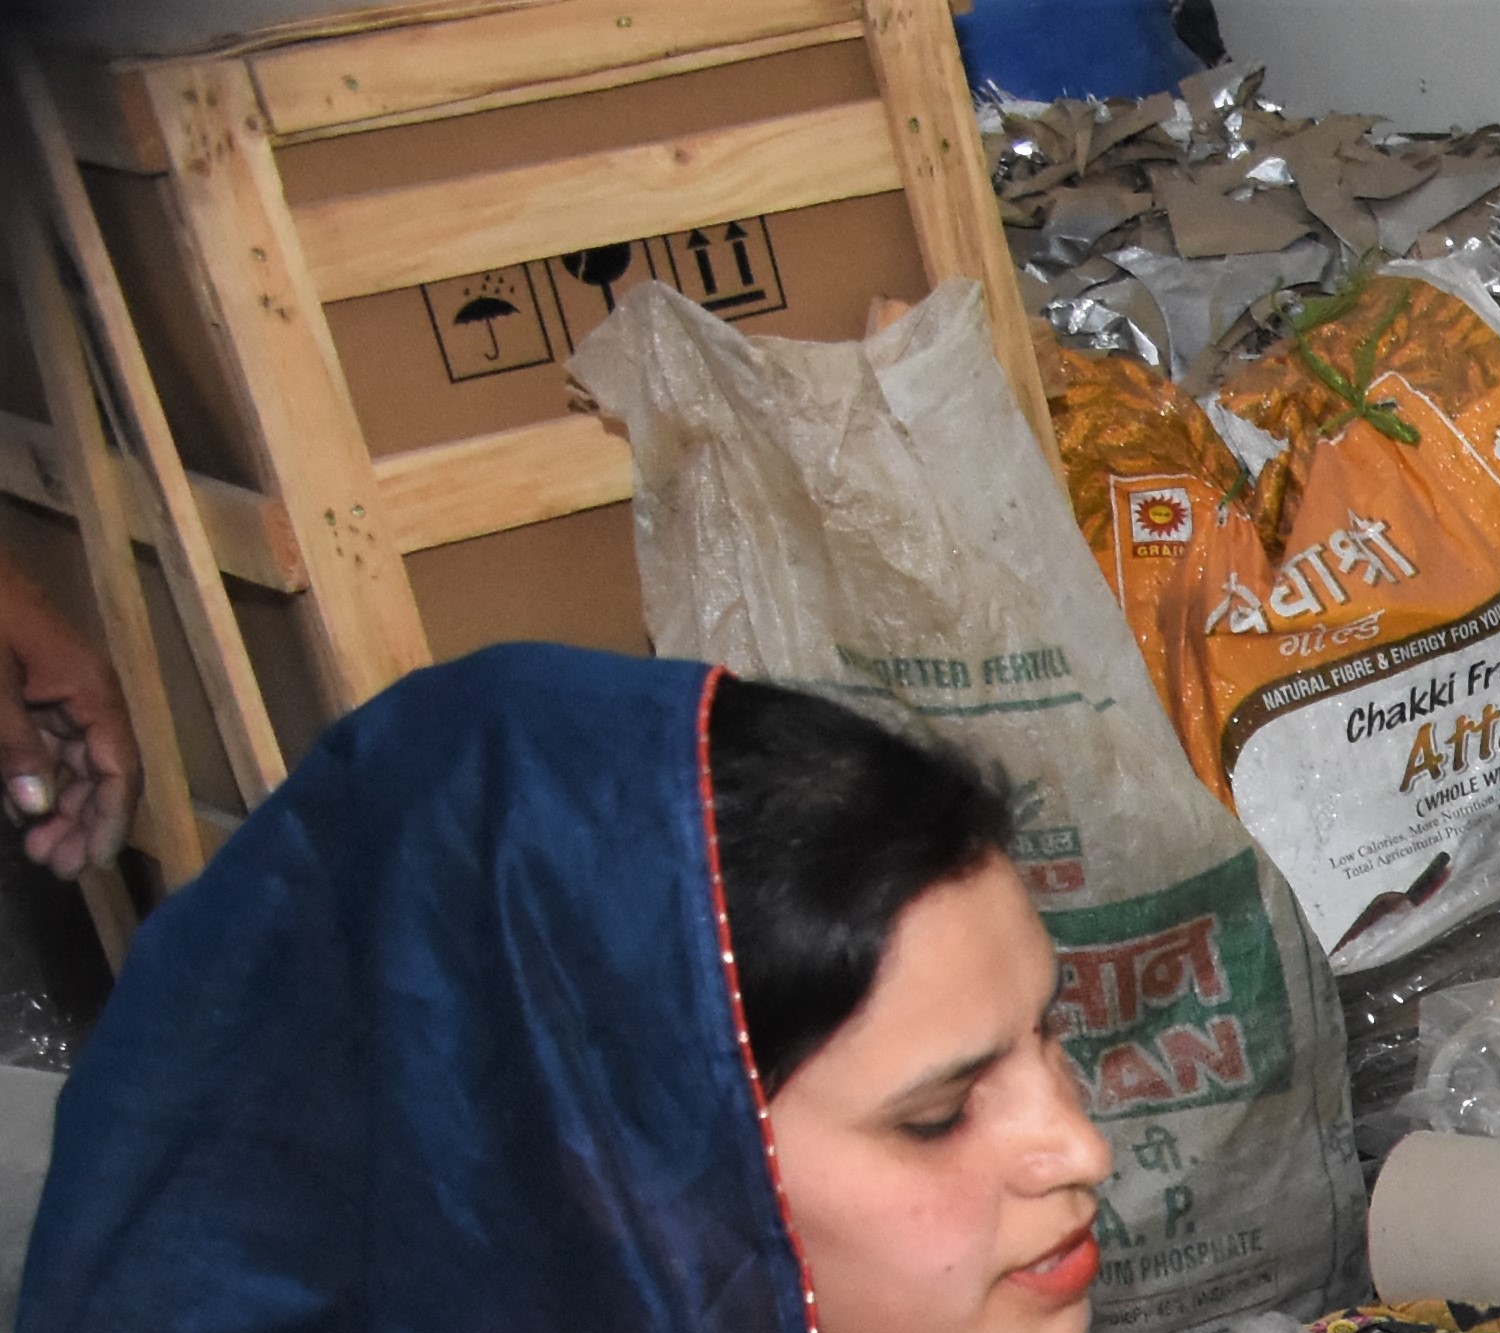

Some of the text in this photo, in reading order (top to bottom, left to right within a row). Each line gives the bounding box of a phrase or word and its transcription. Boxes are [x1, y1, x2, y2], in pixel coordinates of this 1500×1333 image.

[1279, 608, 1386, 657] गोल्ड
[1262, 674, 1330, 711] NATURAL
[1331, 658, 1376, 687] FIBRE
[1378, 653, 1389, 670] &
[1390, 631, 1448, 664] ENERGY
[1450, 620, 1480, 644] FOR
[1346, 672, 1456, 744] Chakki
[1416, 777, 1480, 818] (WHOLE
[1329, 850, 1355, 870] Low
[1408, 819, 1440, 838] More
[1342, 860, 1374, 880] Total
[1377, 831, 1443, 866] Agricultural
